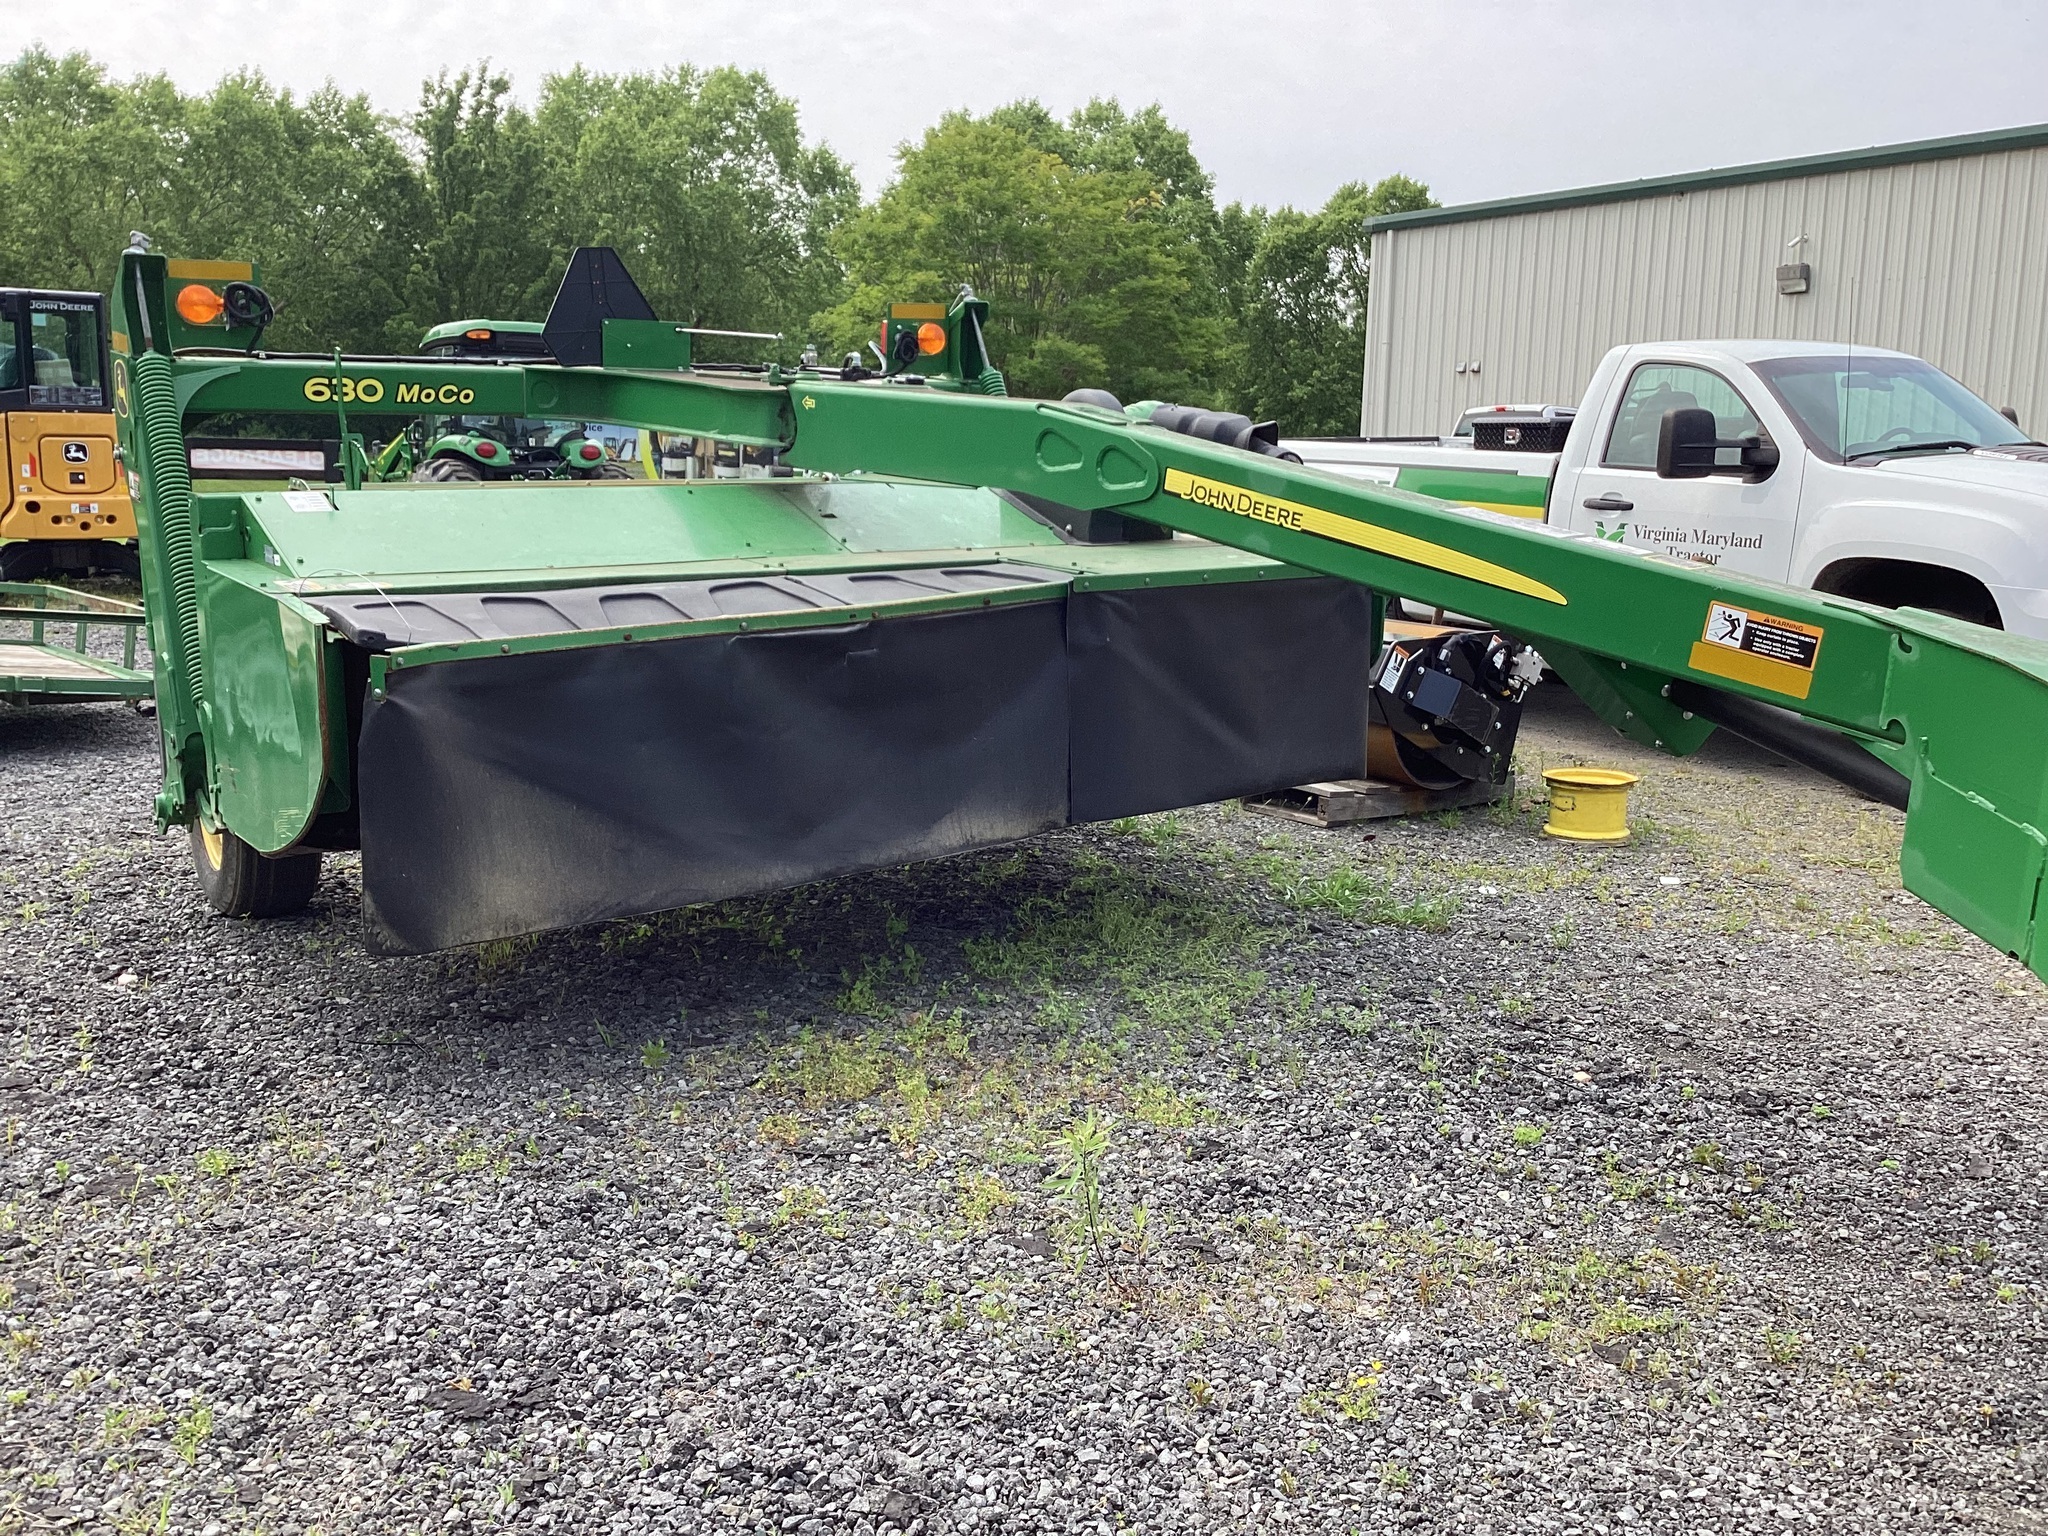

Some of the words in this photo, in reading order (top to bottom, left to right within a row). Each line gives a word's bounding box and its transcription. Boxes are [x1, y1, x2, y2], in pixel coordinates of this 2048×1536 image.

[29, 300, 58, 310] JOHN
[60, 302, 95, 312] DEERE
[304, 377, 385, 403] 630
[396, 384, 475, 404] MoCo
[1183, 480, 1234, 509] JOHN
[1237, 493, 1303, 528] DEERE
[1633, 524, 1687, 544] Virginia
[1691, 528, 1763, 550] Maryland
[1771, 618, 1804, 631] WARNING
